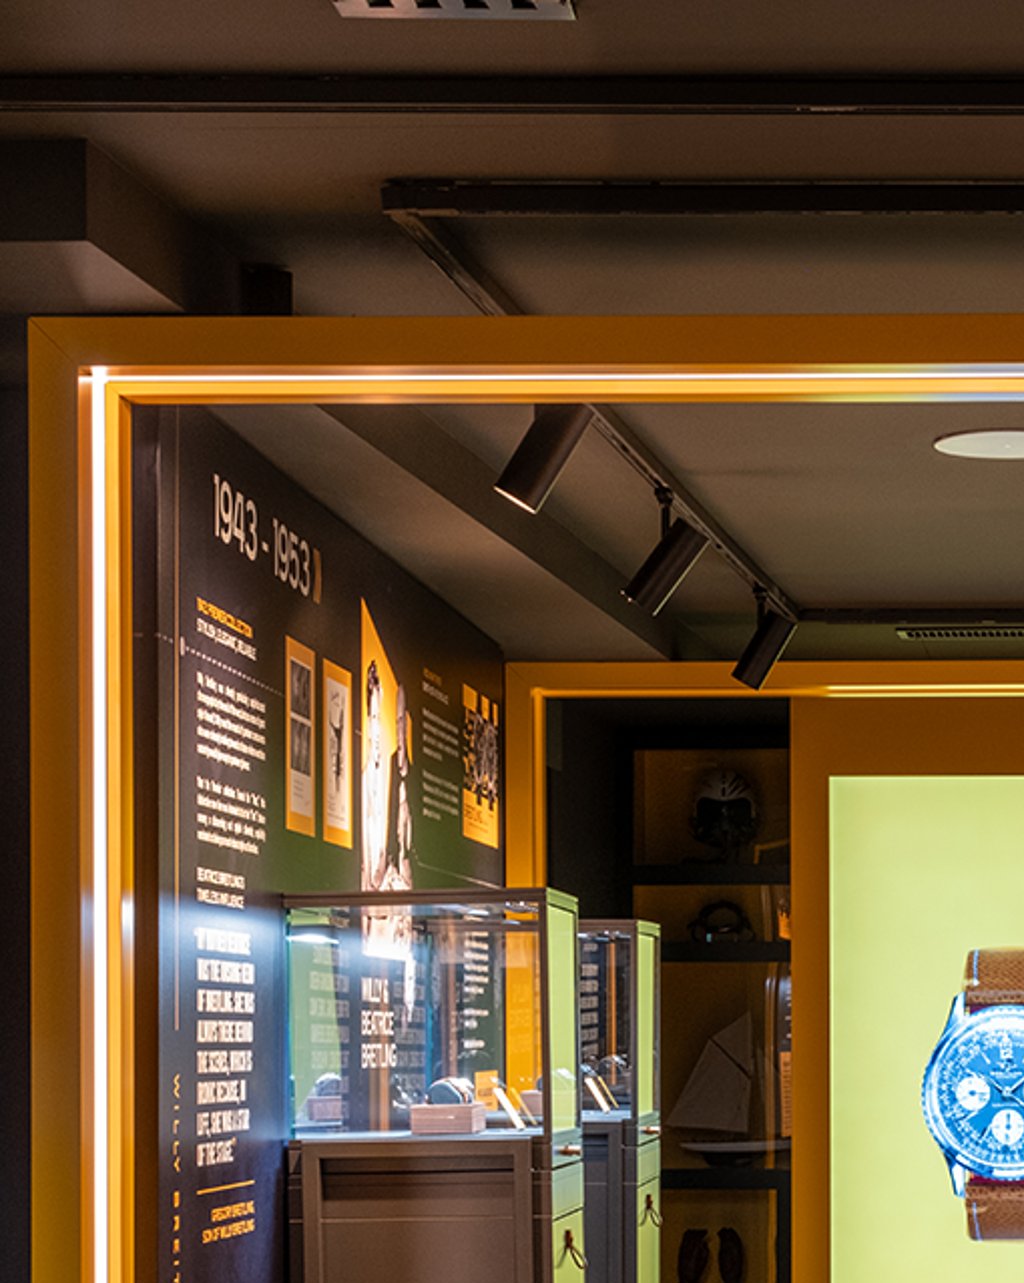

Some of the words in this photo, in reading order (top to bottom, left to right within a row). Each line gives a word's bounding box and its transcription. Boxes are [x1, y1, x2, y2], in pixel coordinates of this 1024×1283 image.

[212, 473, 259, 562] 1943
[271, 517, 311, 598] 1953
[361, 1010, 394, 1037] BEATRICE
[361, 1043, 398, 1069] BREITLING
